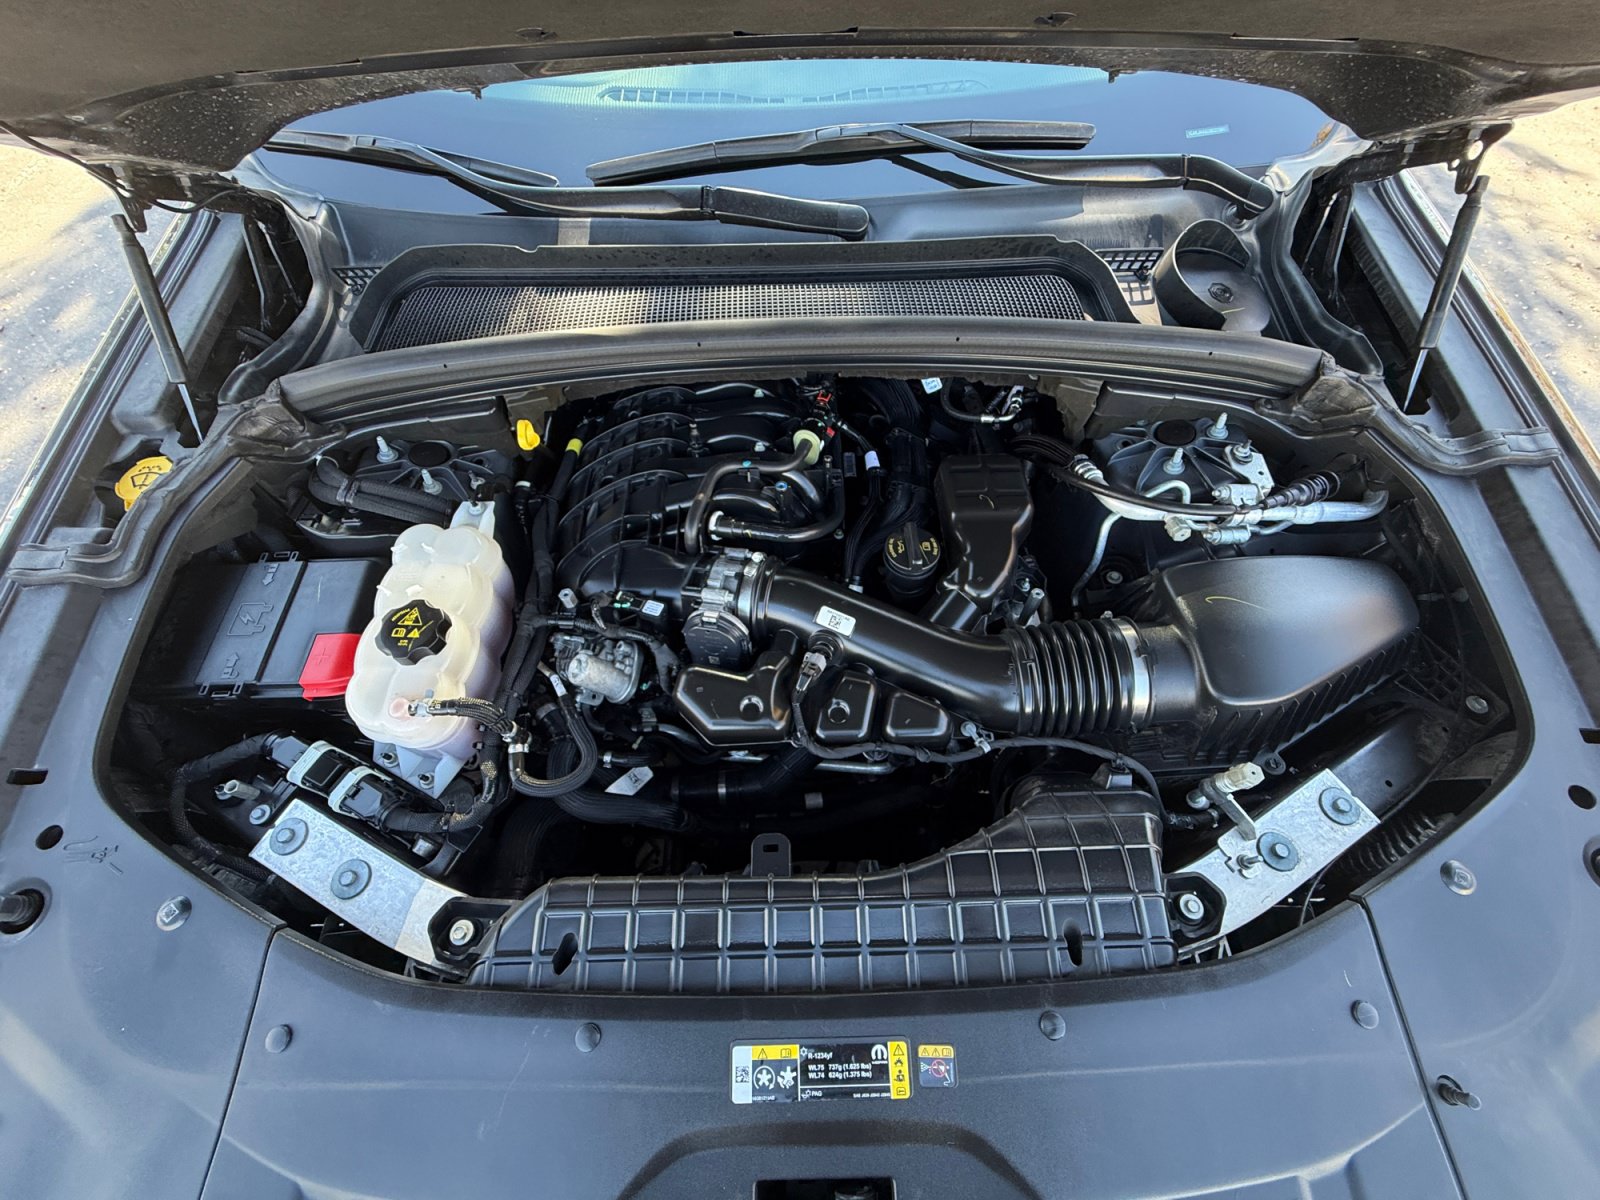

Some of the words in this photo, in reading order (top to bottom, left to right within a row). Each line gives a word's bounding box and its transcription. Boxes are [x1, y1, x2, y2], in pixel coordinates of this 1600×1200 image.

[808, 1052, 833, 1060] R-1234yf
[843, 1063, 860, 1071] (1.625
[843, 1071, 860, 1079] (1.375
